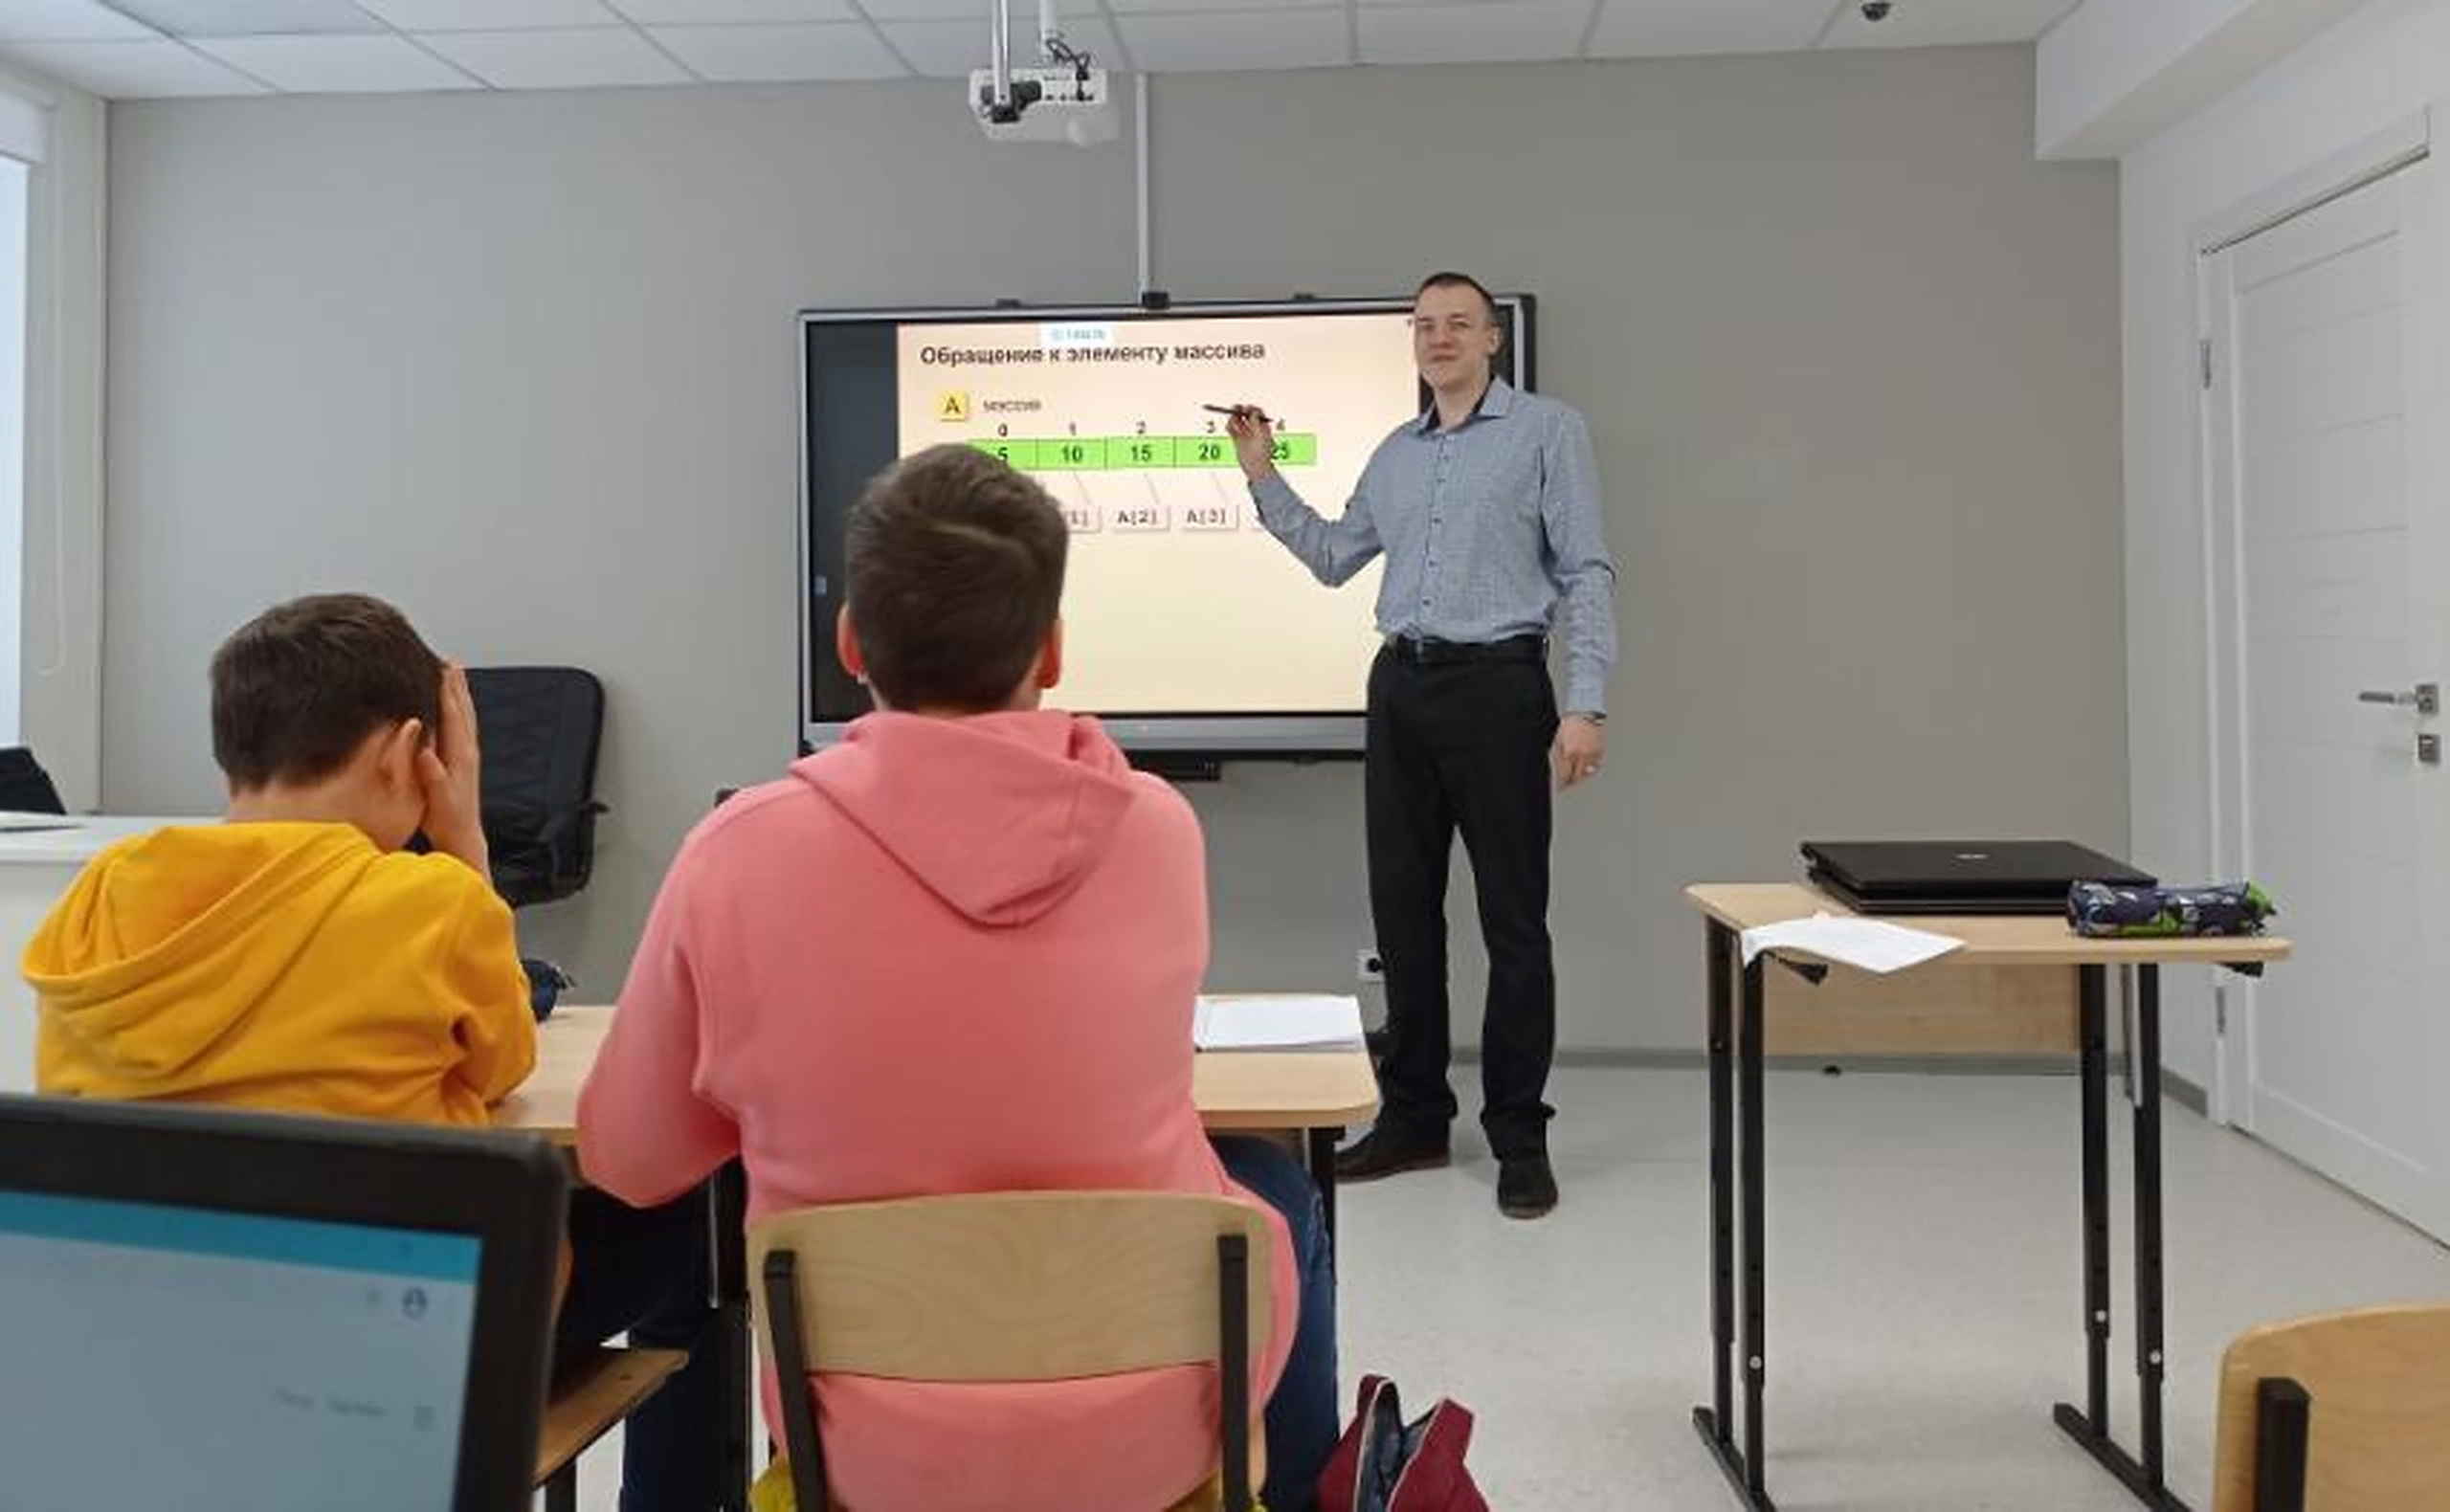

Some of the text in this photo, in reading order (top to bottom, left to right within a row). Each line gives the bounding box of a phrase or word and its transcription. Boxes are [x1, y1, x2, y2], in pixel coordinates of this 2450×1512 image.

[921, 343, 1265, 367] Обращение к элементу массива
[997, 422, 1008, 437] 0
[1136, 420, 1147, 435] 2
[1061, 445, 1083, 462] 10
[1131, 444, 1152, 461] 15
[1198, 444, 1220, 460] 20
[1118, 509, 1158, 526] A[2]
[1187, 508, 1226, 526] A[3]
